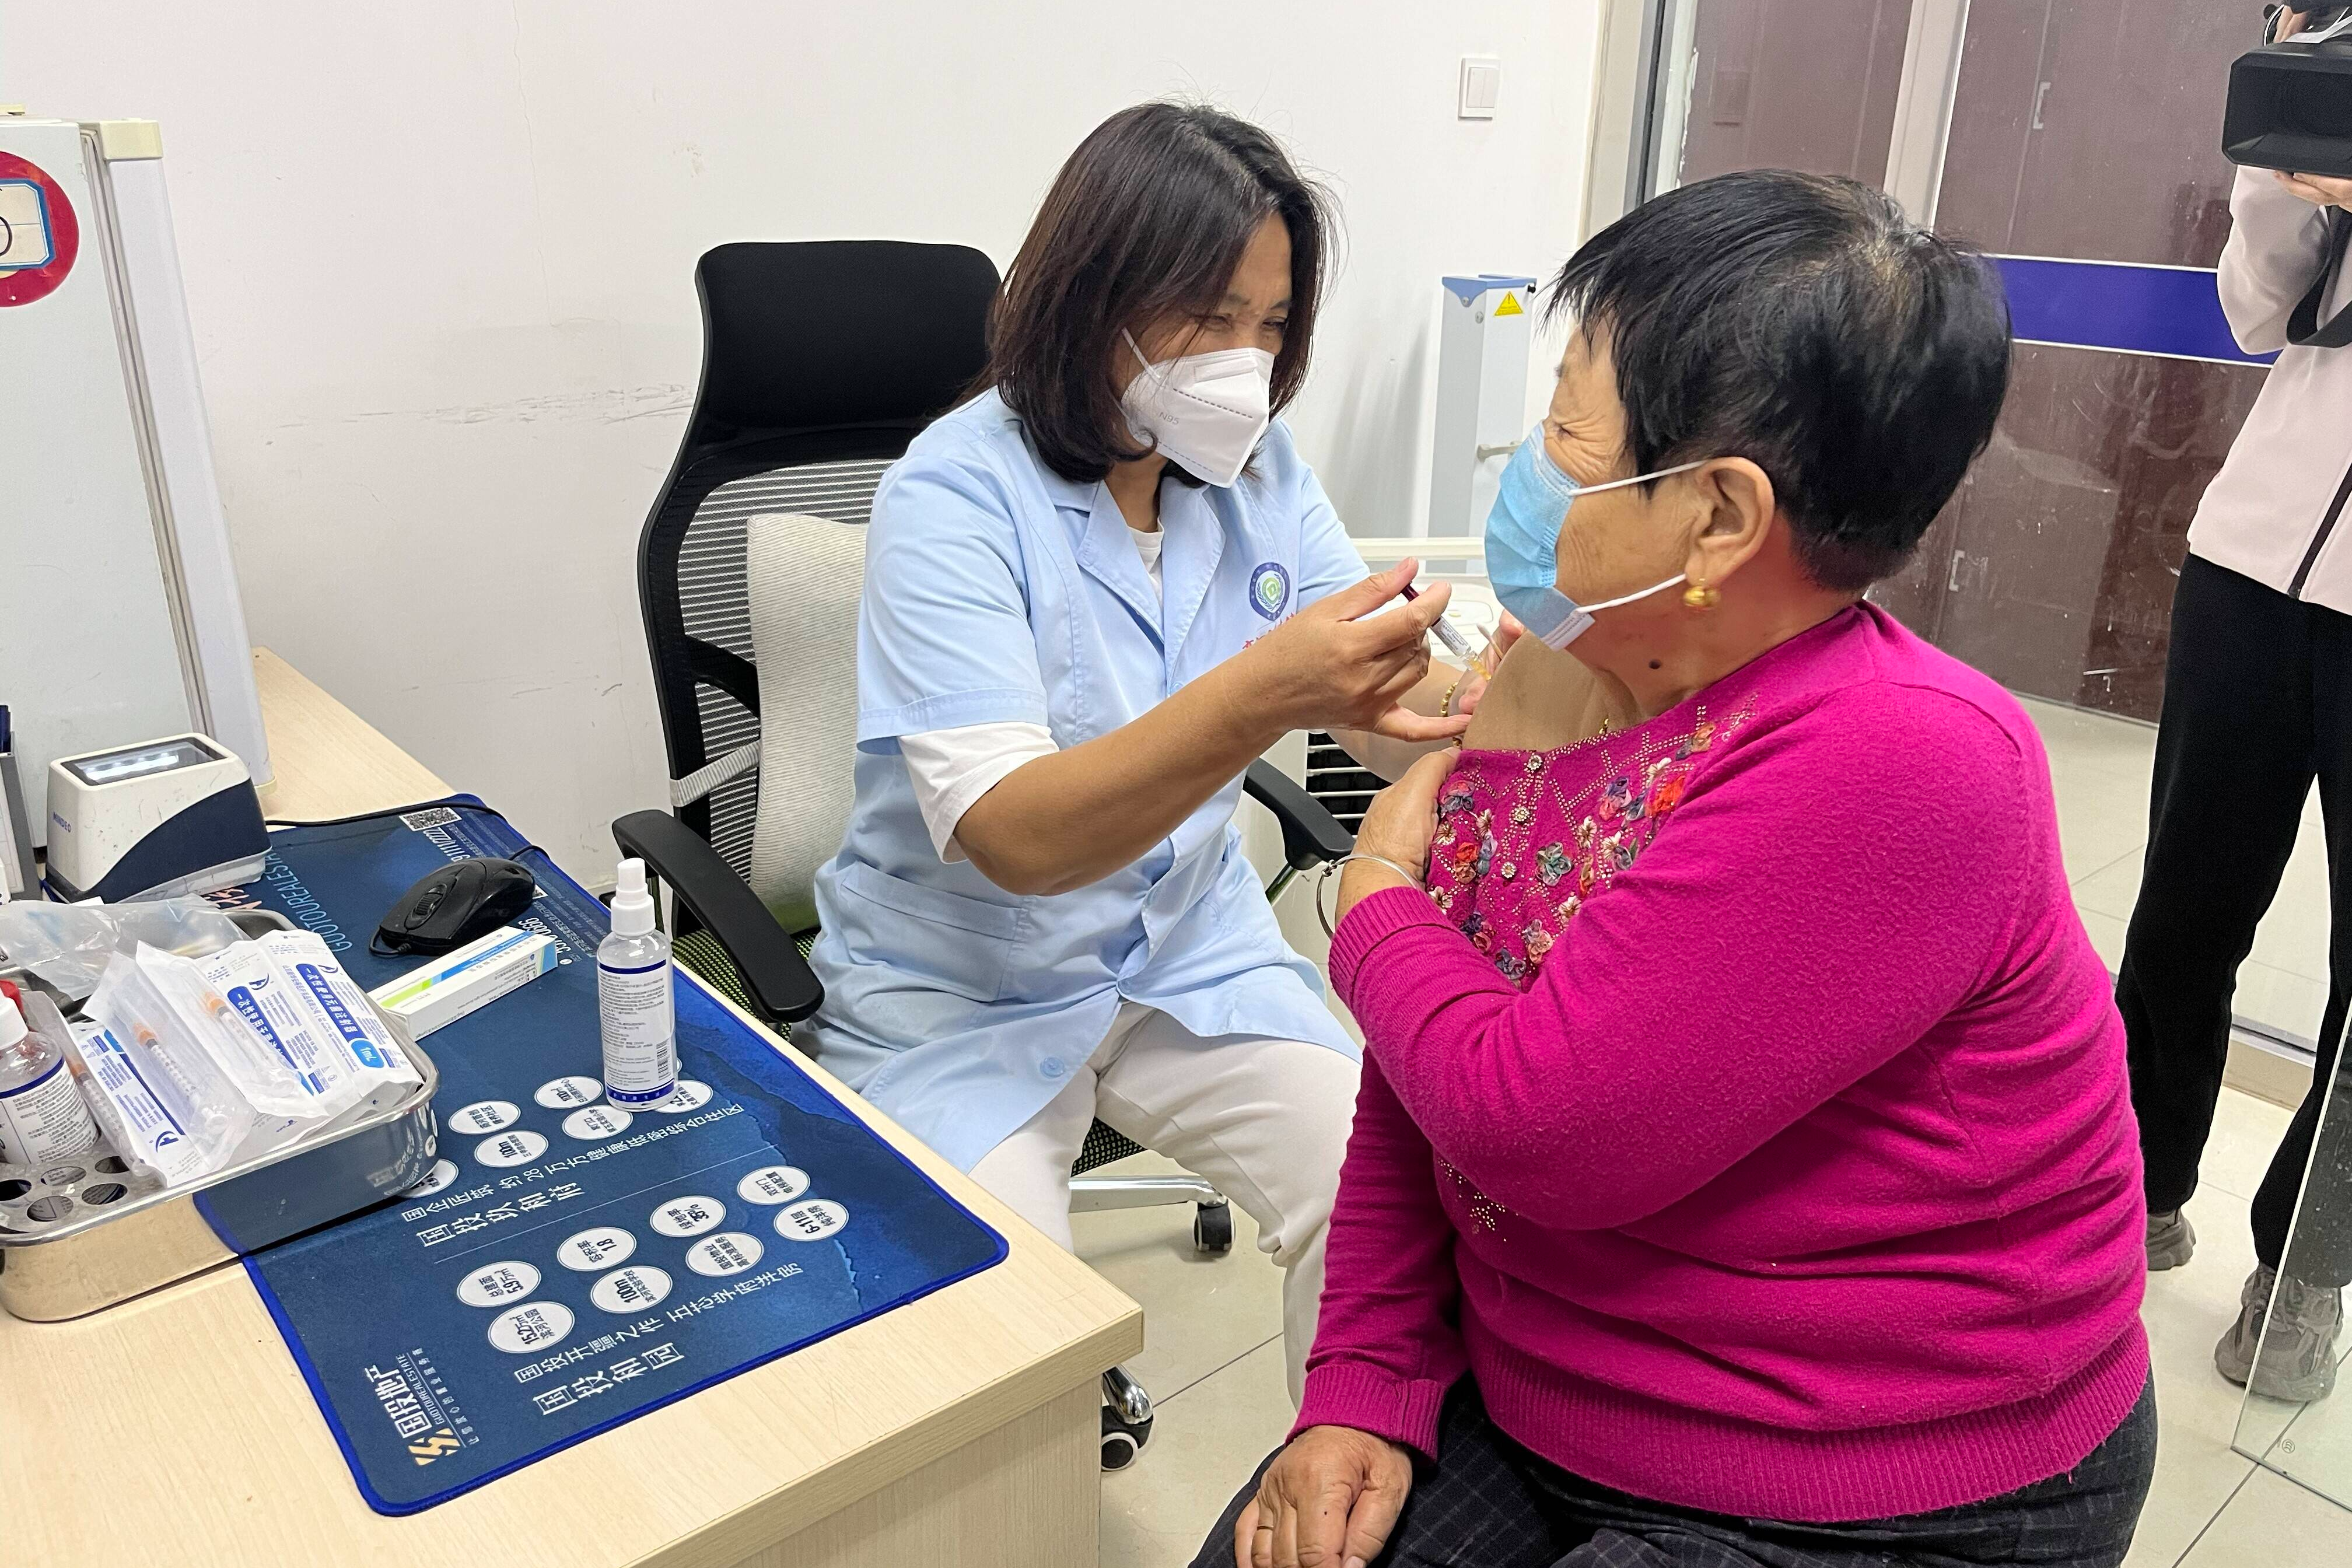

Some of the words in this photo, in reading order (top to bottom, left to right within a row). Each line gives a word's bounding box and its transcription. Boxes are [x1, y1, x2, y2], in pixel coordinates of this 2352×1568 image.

[1158, 411, 1180, 425] N95
[265, 851, 352, 952] GUOTOUREALESTA
[305, 967, 358, 1033] 一次性使用无菌注射器
[360, 1046, 374, 1062] 1mL
[755, 1178, 779, 1197] 双开门
[766, 1171, 794, 1194] 电梯配置
[401, 1184, 495, 1222] 国企匠筑
[416, 1181, 585, 1247] 国投玖和府
[685, 1203, 709, 1223] 35%
[668, 1208, 695, 1230] 绿地率
[790, 1210, 820, 1234] 6-11层
[807, 1205, 836, 1228] 纯洋房
[577, 1240, 604, 1264] 容积率
[596, 1238, 617, 1252] 1.8
[704, 1244, 734, 1270] 国投物业
[715, 1236, 751, 1268] 高标准服务
[478, 1275, 504, 1297] 总建面
[614, 1279, 640, 1303] 100m
[624, 1269, 657, 1303] 滨河实验学校
[514, 1317, 664, 1382] 国投开疆之作
[667, 1262, 804, 1322] 五芯学府洋房
[525, 1308, 555, 1340] 滨河公园
[533, 1342, 684, 1415] 国投和园
[365, 1364, 432, 1438] 国投地产
